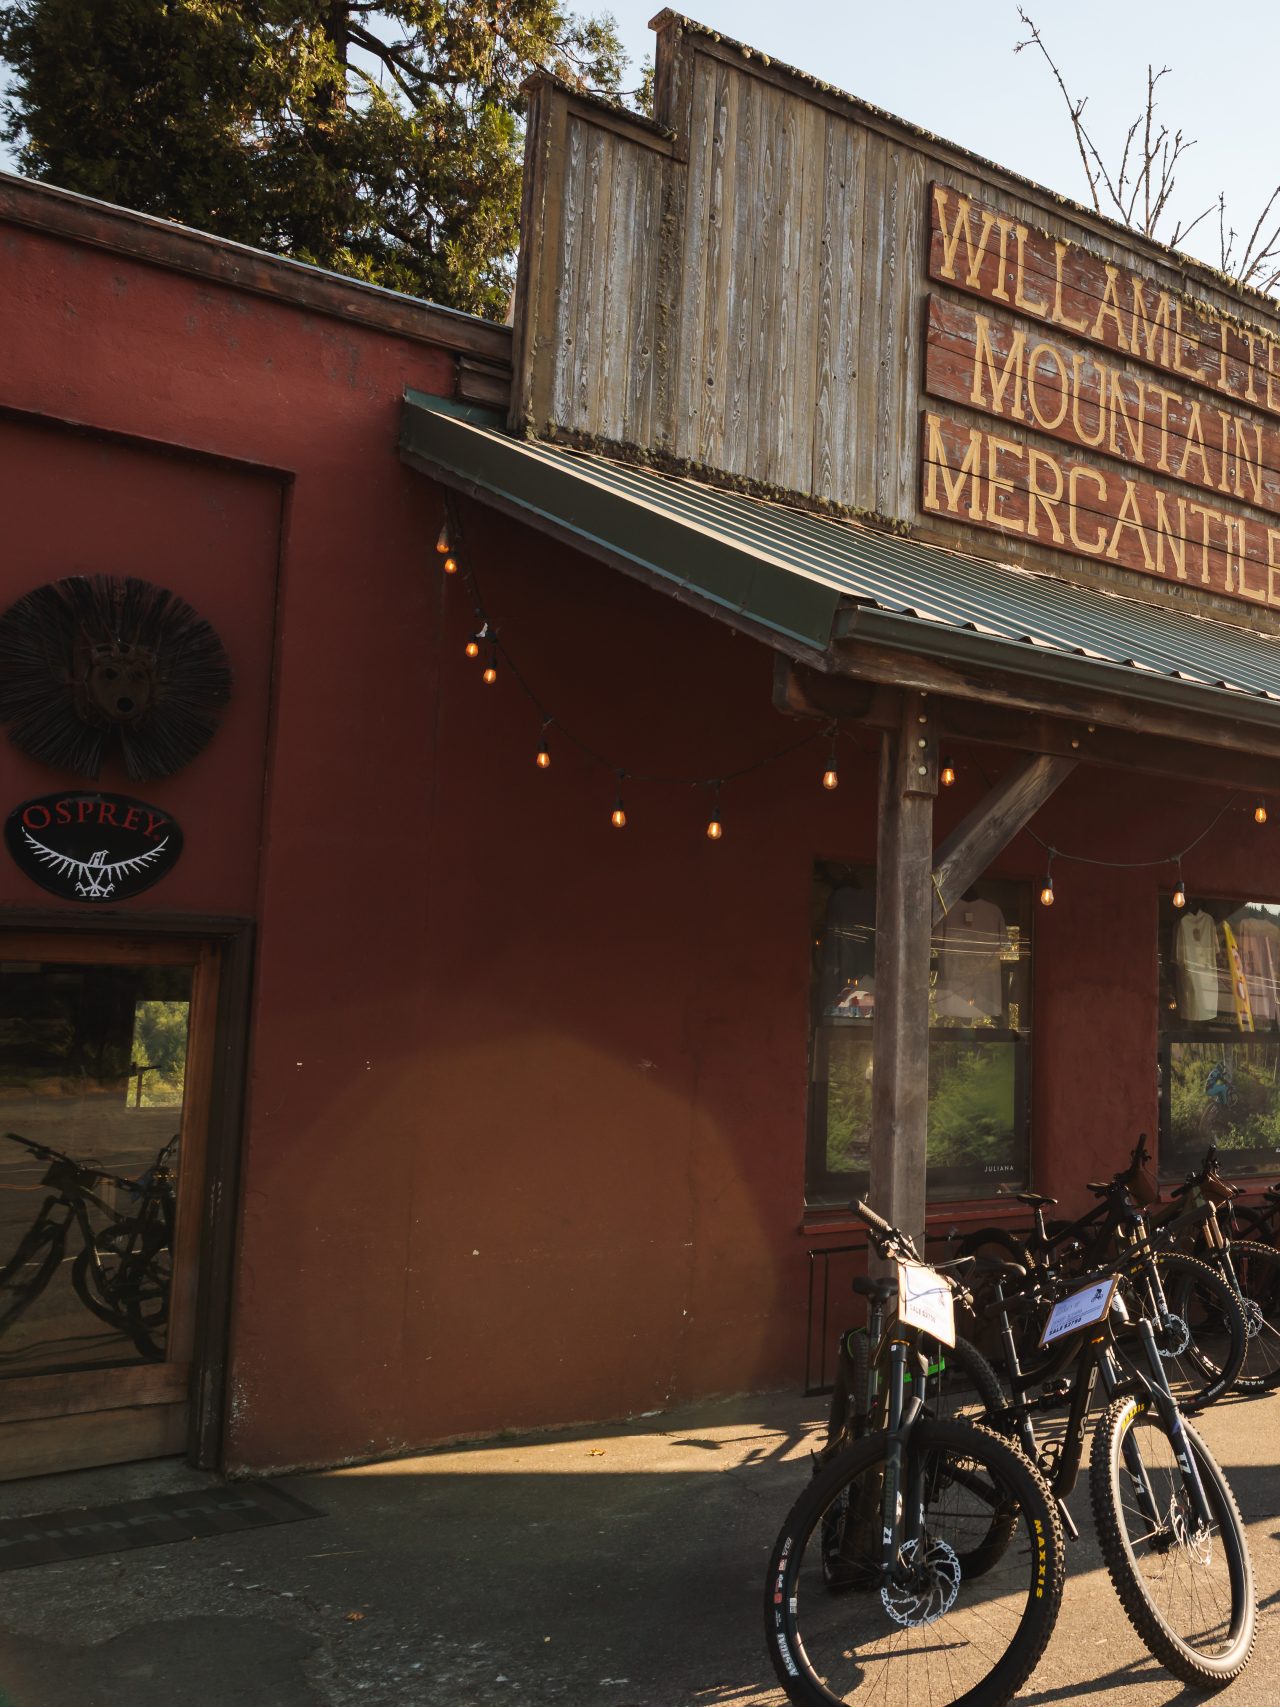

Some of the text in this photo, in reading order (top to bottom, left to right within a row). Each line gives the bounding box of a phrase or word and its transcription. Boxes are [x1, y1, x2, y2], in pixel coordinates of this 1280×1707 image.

[971, 315, 1264, 505] MOUNTAIN
[22, 800, 168, 837] OSPREY
[984, 1164, 1014, 1173] JULIANA
[1049, 1326, 1063, 1336] SALE
[1033, 1519, 1046, 1599] MAXXIS
